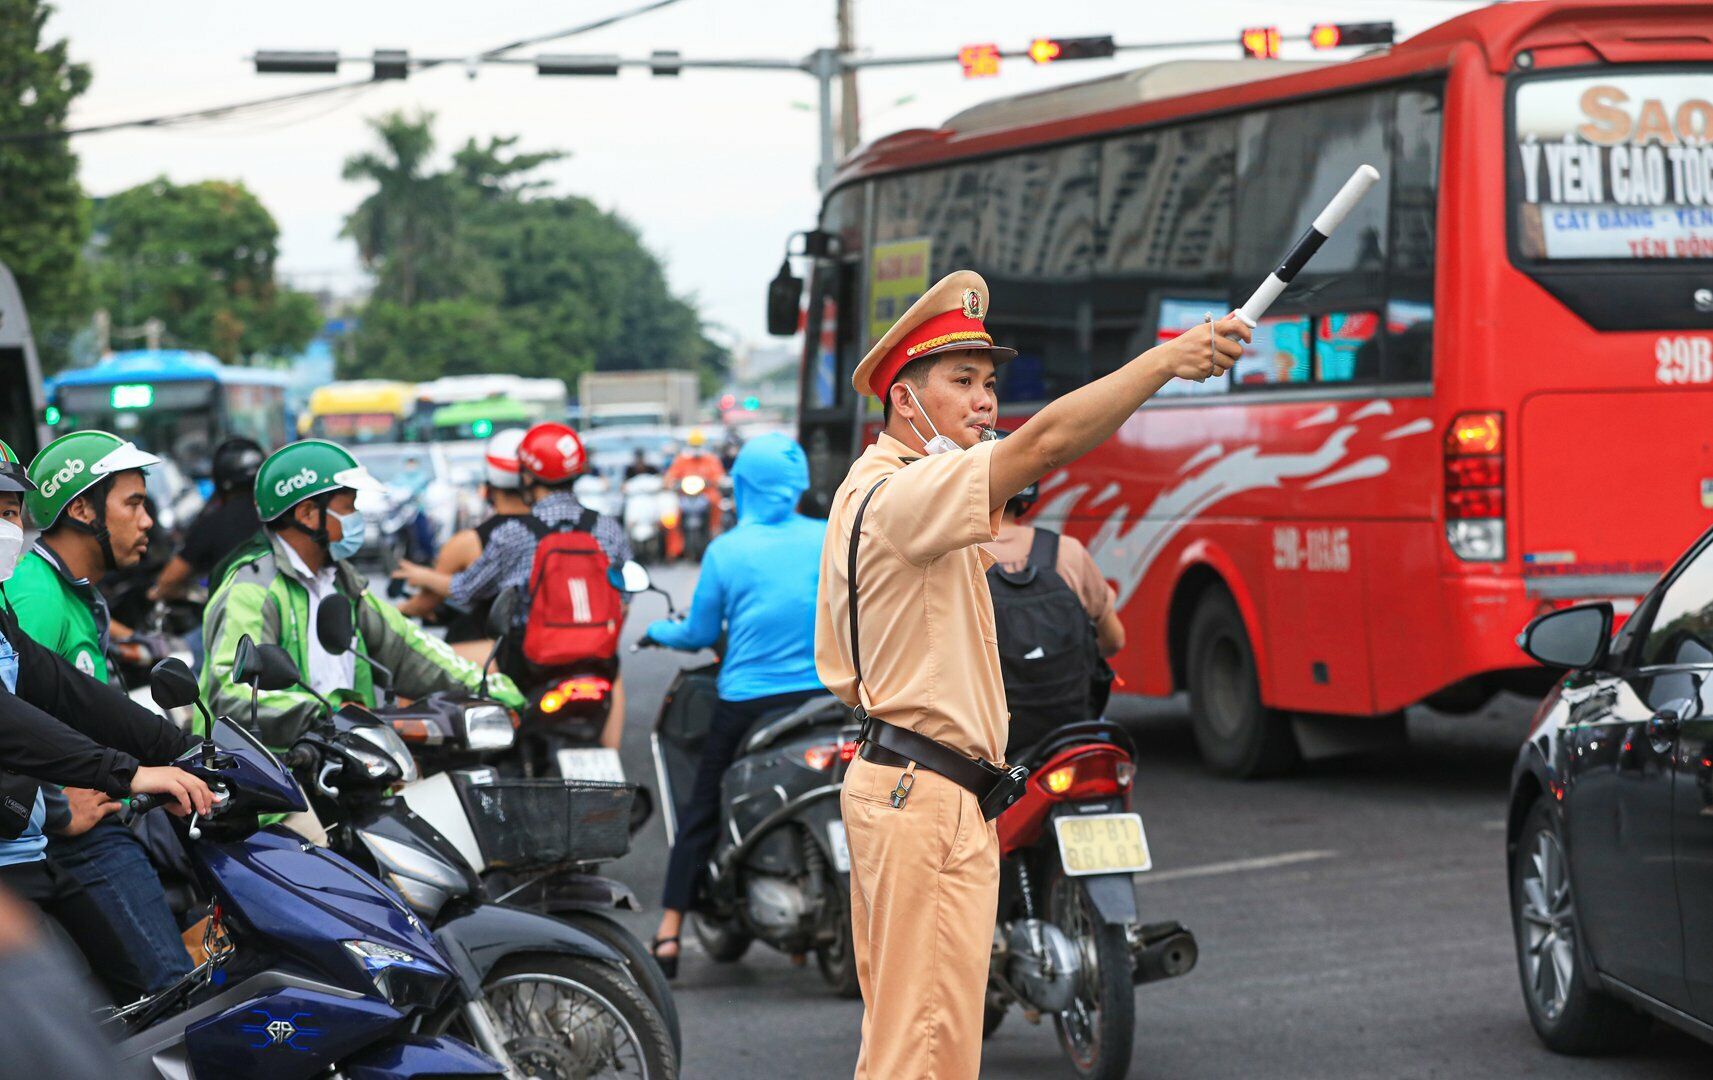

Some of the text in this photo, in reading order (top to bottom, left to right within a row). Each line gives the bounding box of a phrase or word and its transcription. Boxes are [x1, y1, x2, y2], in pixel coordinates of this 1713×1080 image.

[1609, 144, 1666, 206] CAO
[40, 458, 85, 499] Grab
[274, 466, 318, 498] Grab
